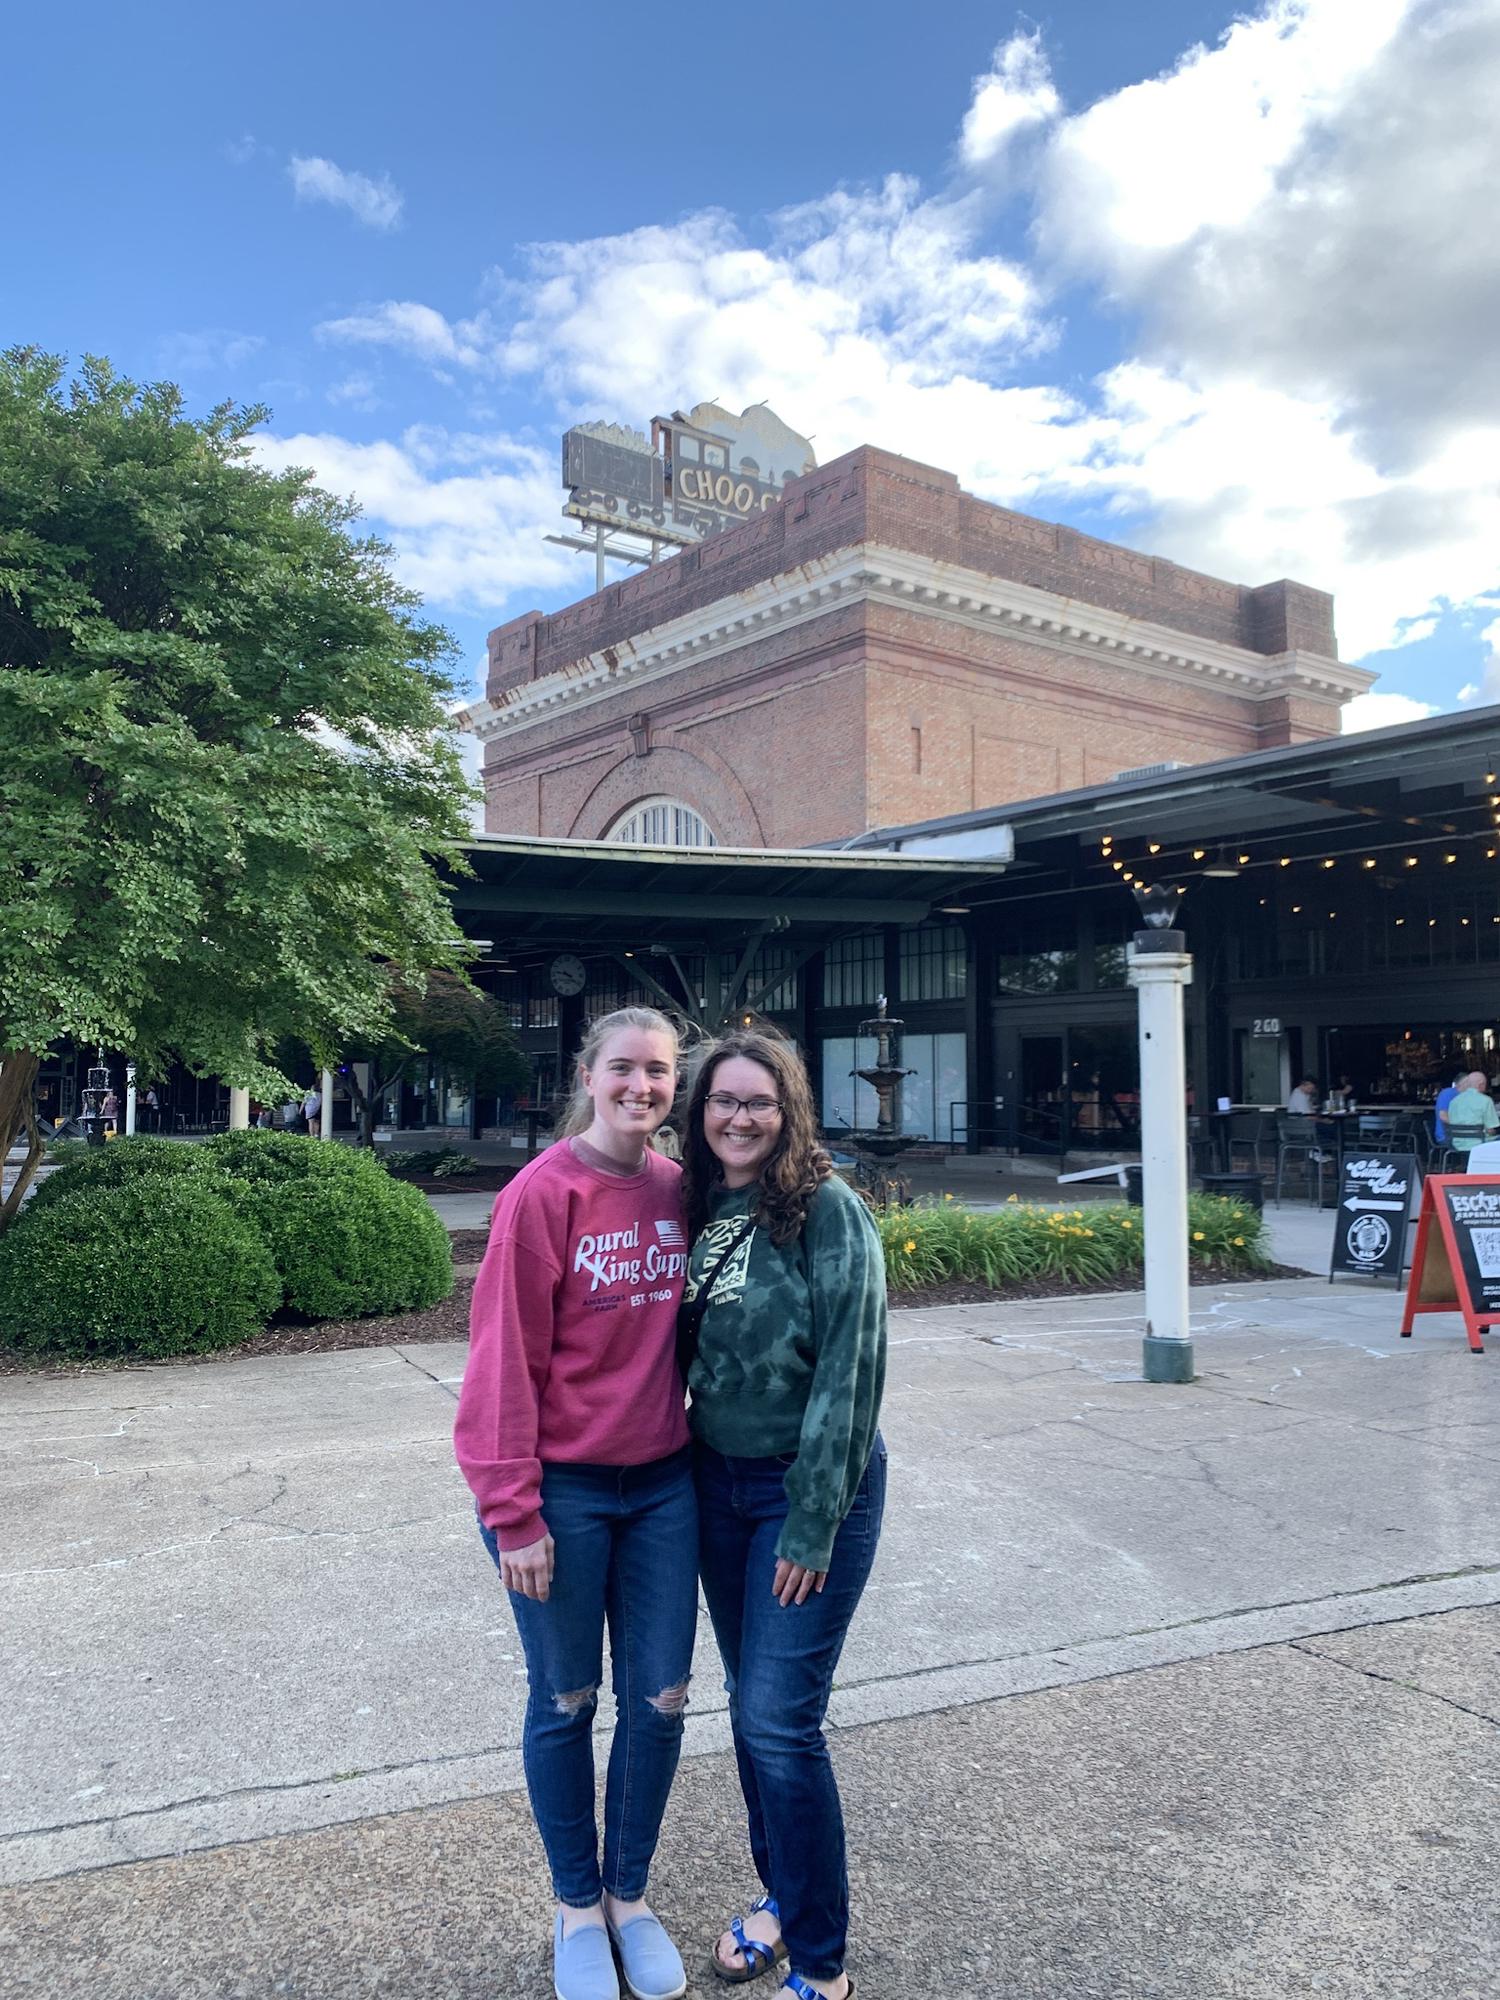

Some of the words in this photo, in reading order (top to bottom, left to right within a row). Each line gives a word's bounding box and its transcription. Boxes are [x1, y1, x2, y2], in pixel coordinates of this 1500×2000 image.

[680, 468, 782, 513] CHOO-C
[574, 1221, 640, 1273] Rural
[590, 1253, 642, 1292] King
[630, 1294, 647, 1307] EST.
[648, 1289, 673, 1303] 1960
